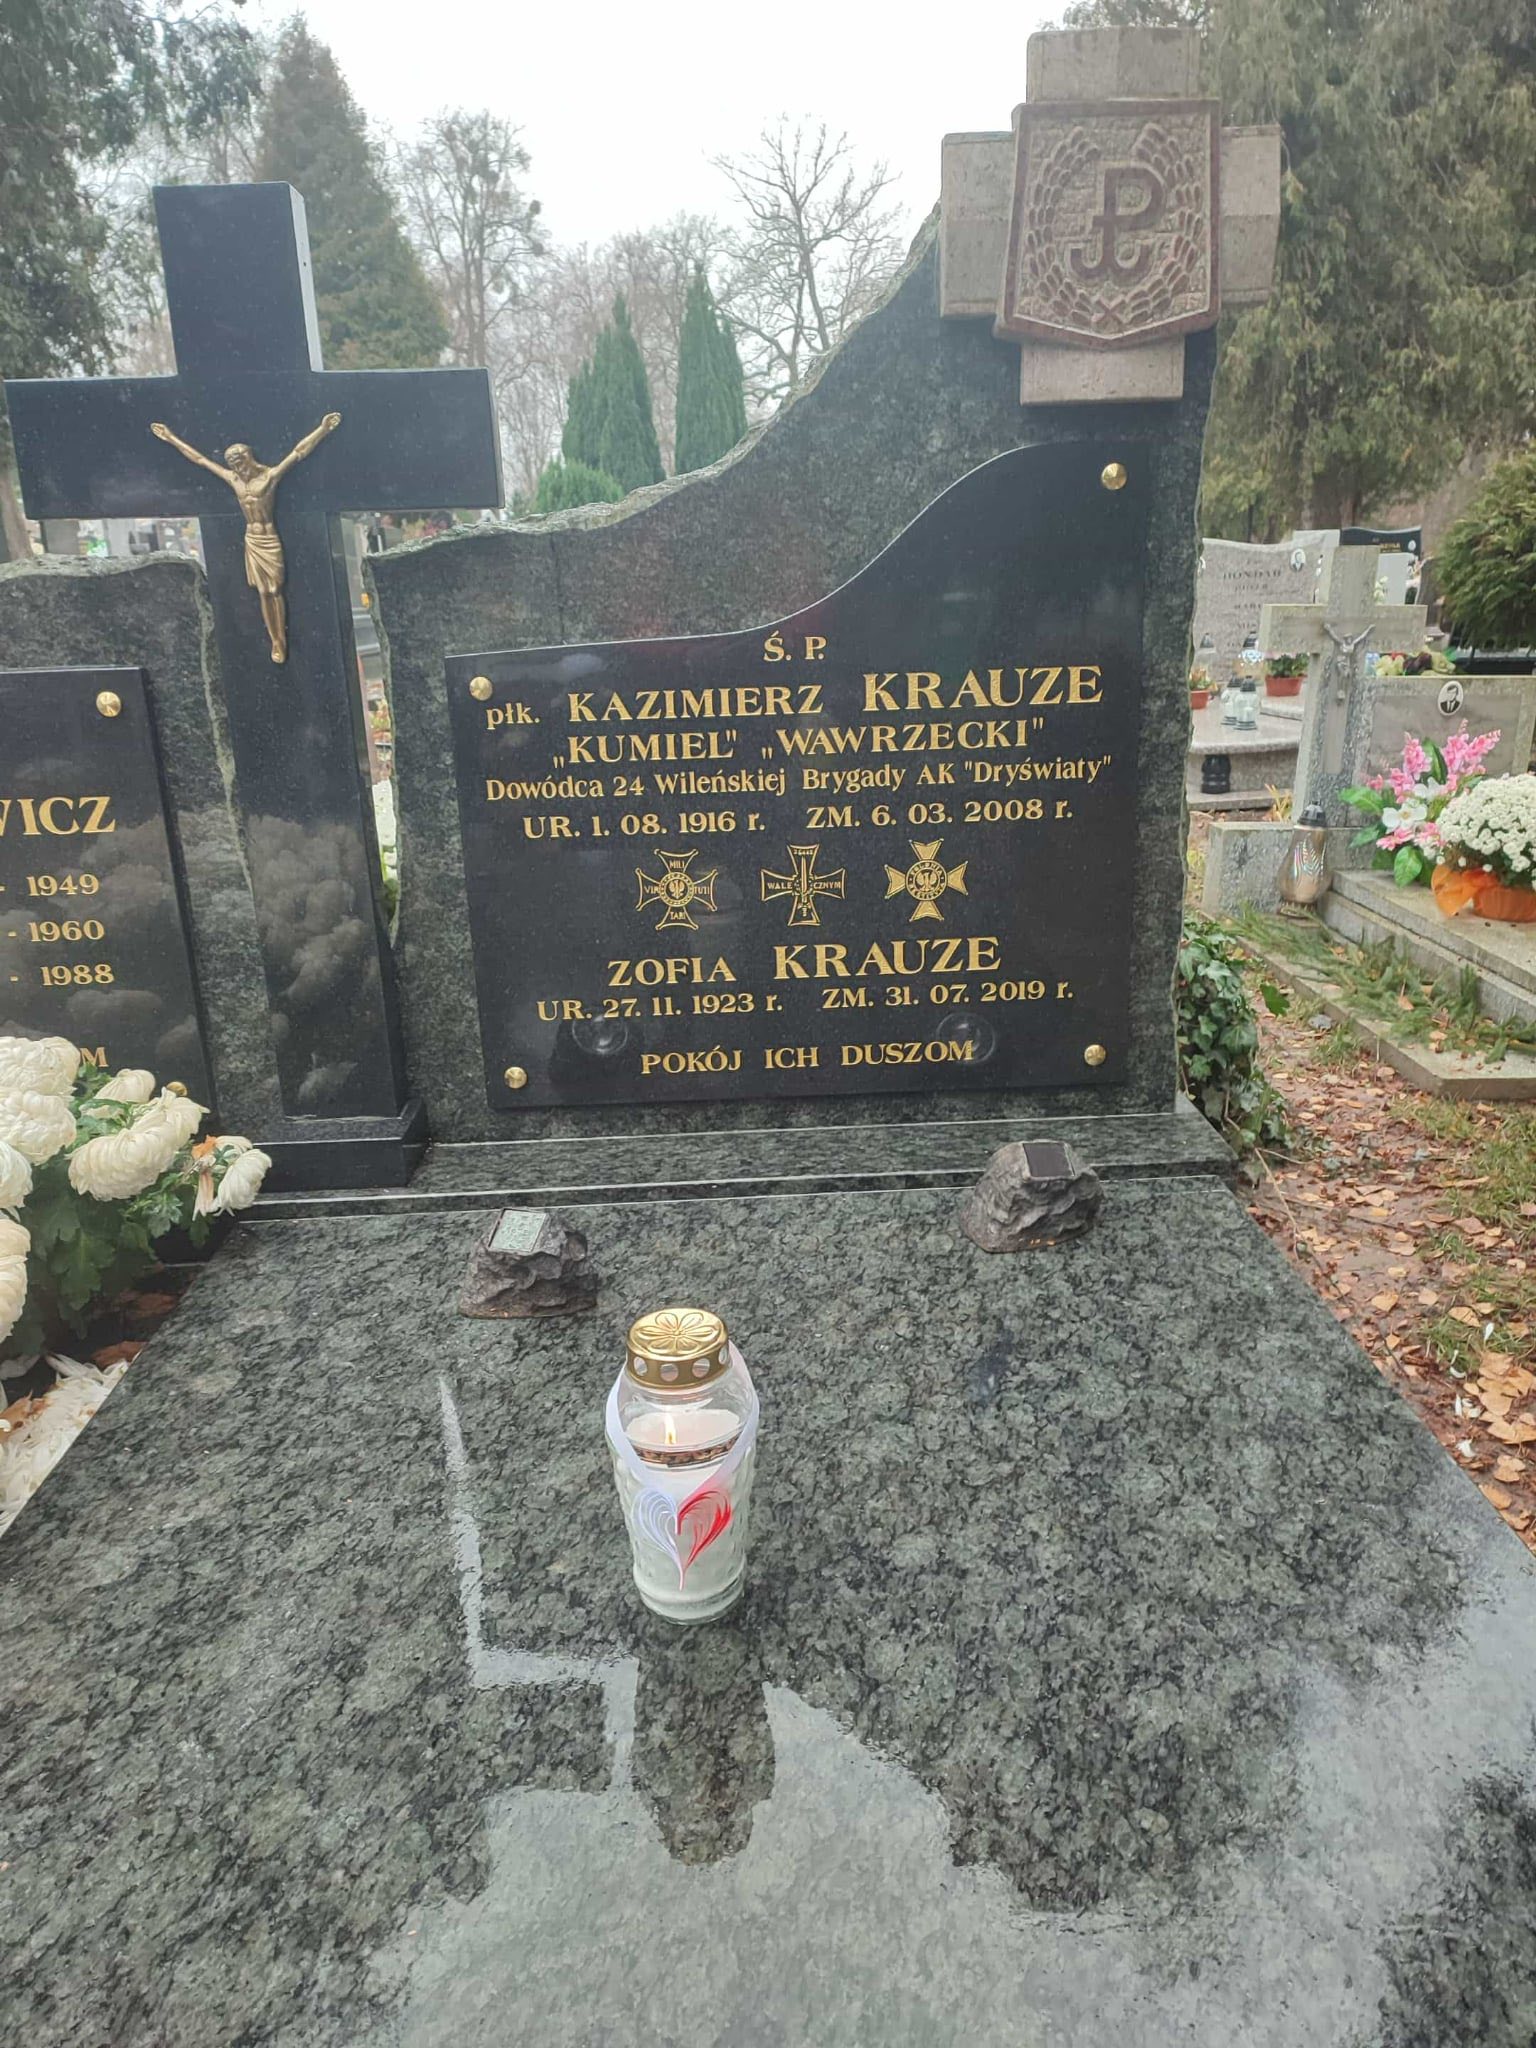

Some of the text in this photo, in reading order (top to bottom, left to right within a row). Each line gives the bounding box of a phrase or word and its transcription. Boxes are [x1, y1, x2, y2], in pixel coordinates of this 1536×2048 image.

[763, 629, 827, 661] Ś. P.
[485, 665, 1103, 730] płk. KAZIMIERZ KRAUZE
[486, 775, 604, 801] Dowódca
[613, 775, 645, 797] 24
[655, 768, 786, 796] Wileńskiej
[802, 764, 905, 794] Brygady
[918, 763, 956, 785] AK
[523, 811, 765, 839] UR. 1. 08. 1916 r.
[807, 798, 1073, 829] ZM. 6. 03. 2008 r.
[26, 874, 100, 897] 1949
[29, 920, 106, 942] 1960
[40, 964, 115, 986] 1988
[607, 936, 1001, 987] ZOFIA KRAUZE
[537, 992, 783, 1022] UR. 27. 11. 1923 r.
[823, 980, 1073, 1009] ZM. 31. 07. 2019 r.
[641, 1039, 974, 1075] POKÓJ ICH DUSZOM
